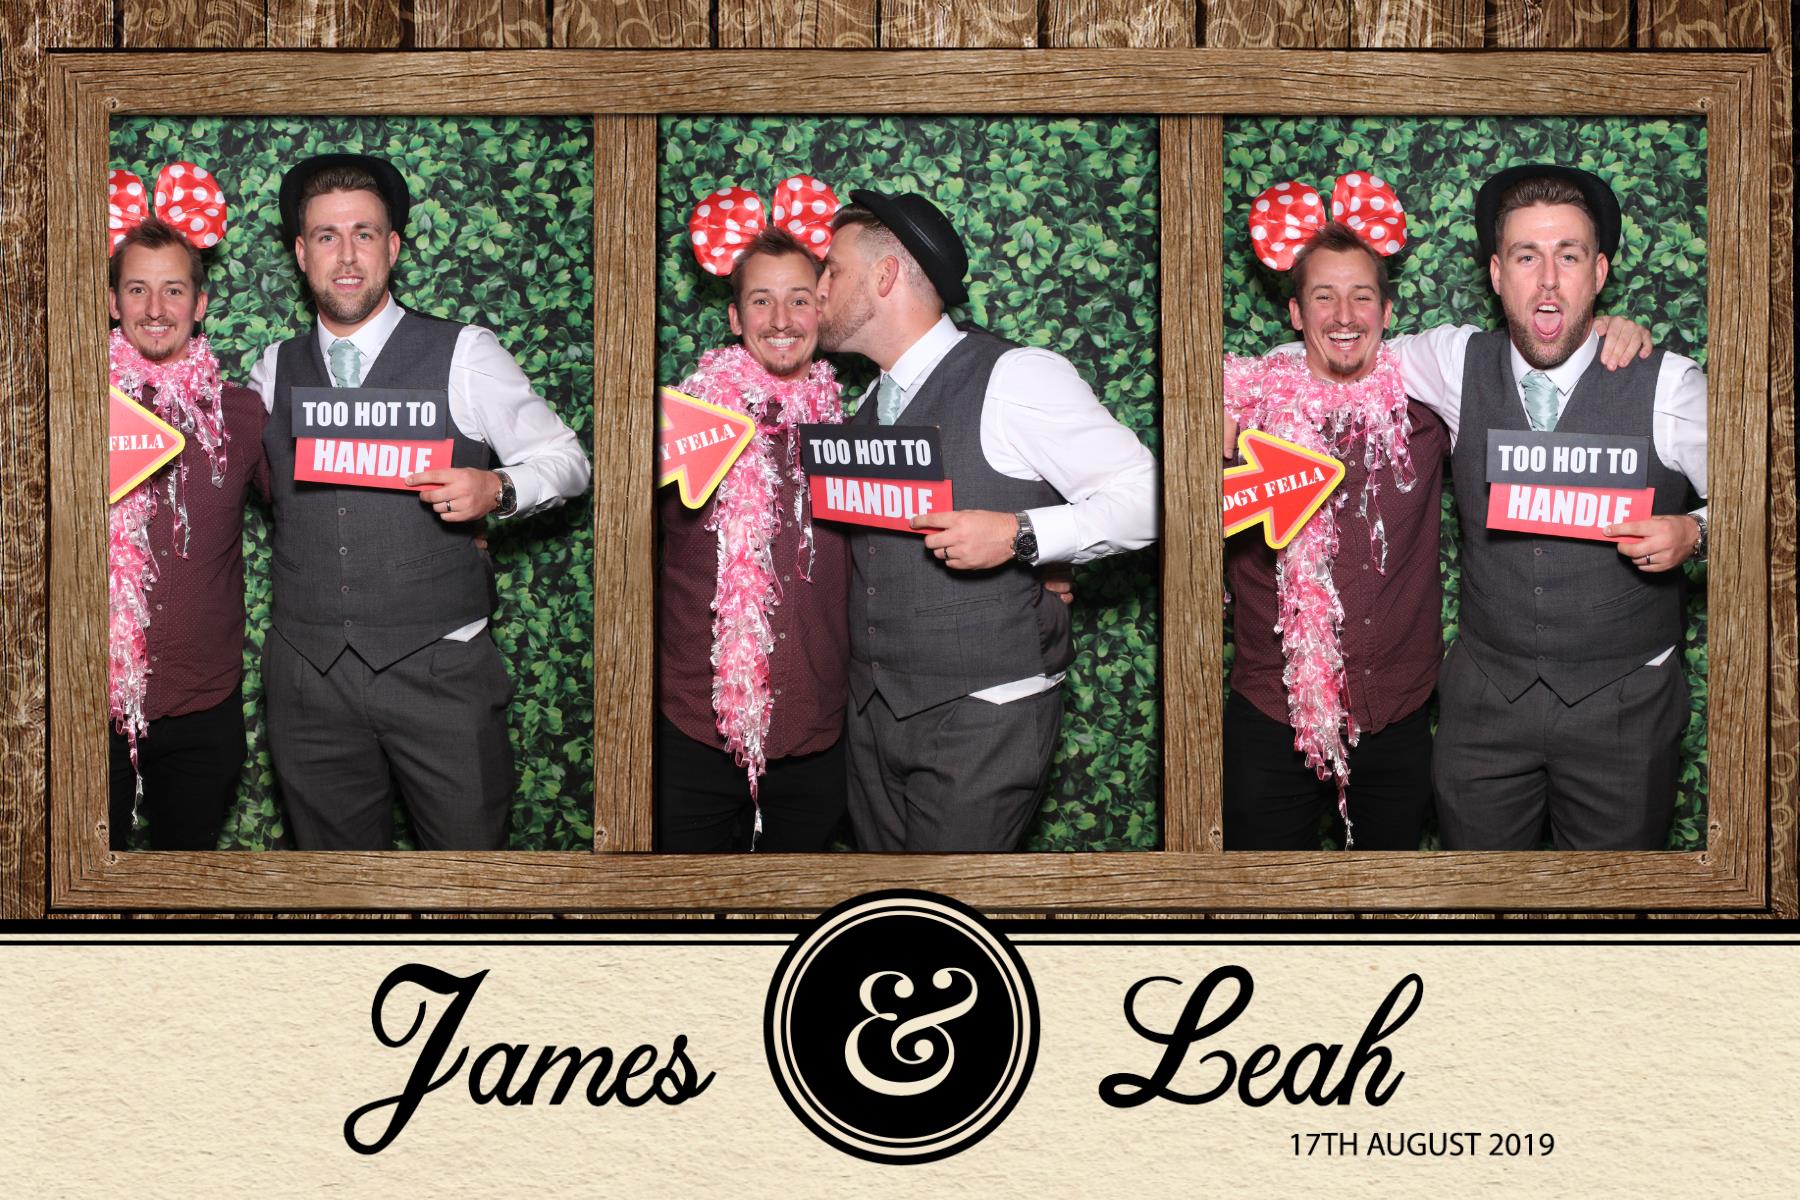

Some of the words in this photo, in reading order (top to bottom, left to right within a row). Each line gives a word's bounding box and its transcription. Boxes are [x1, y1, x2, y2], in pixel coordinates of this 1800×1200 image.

[302, 401, 349, 427] TOO
[355, 401, 402, 427] HOT
[406, 401, 437, 427] TO
[109, 433, 165, 452] FELLA
[675, 423, 736, 455] FELLA
[809, 439, 851, 465] TOO
[854, 439, 897, 466] HOT
[900, 439, 932, 466] TO
[1498, 445, 1547, 472] TOO
[1552, 446, 1602, 473] HOT
[1606, 447, 1638, 475] TO
[1264, 467, 1325, 498] FELLA
